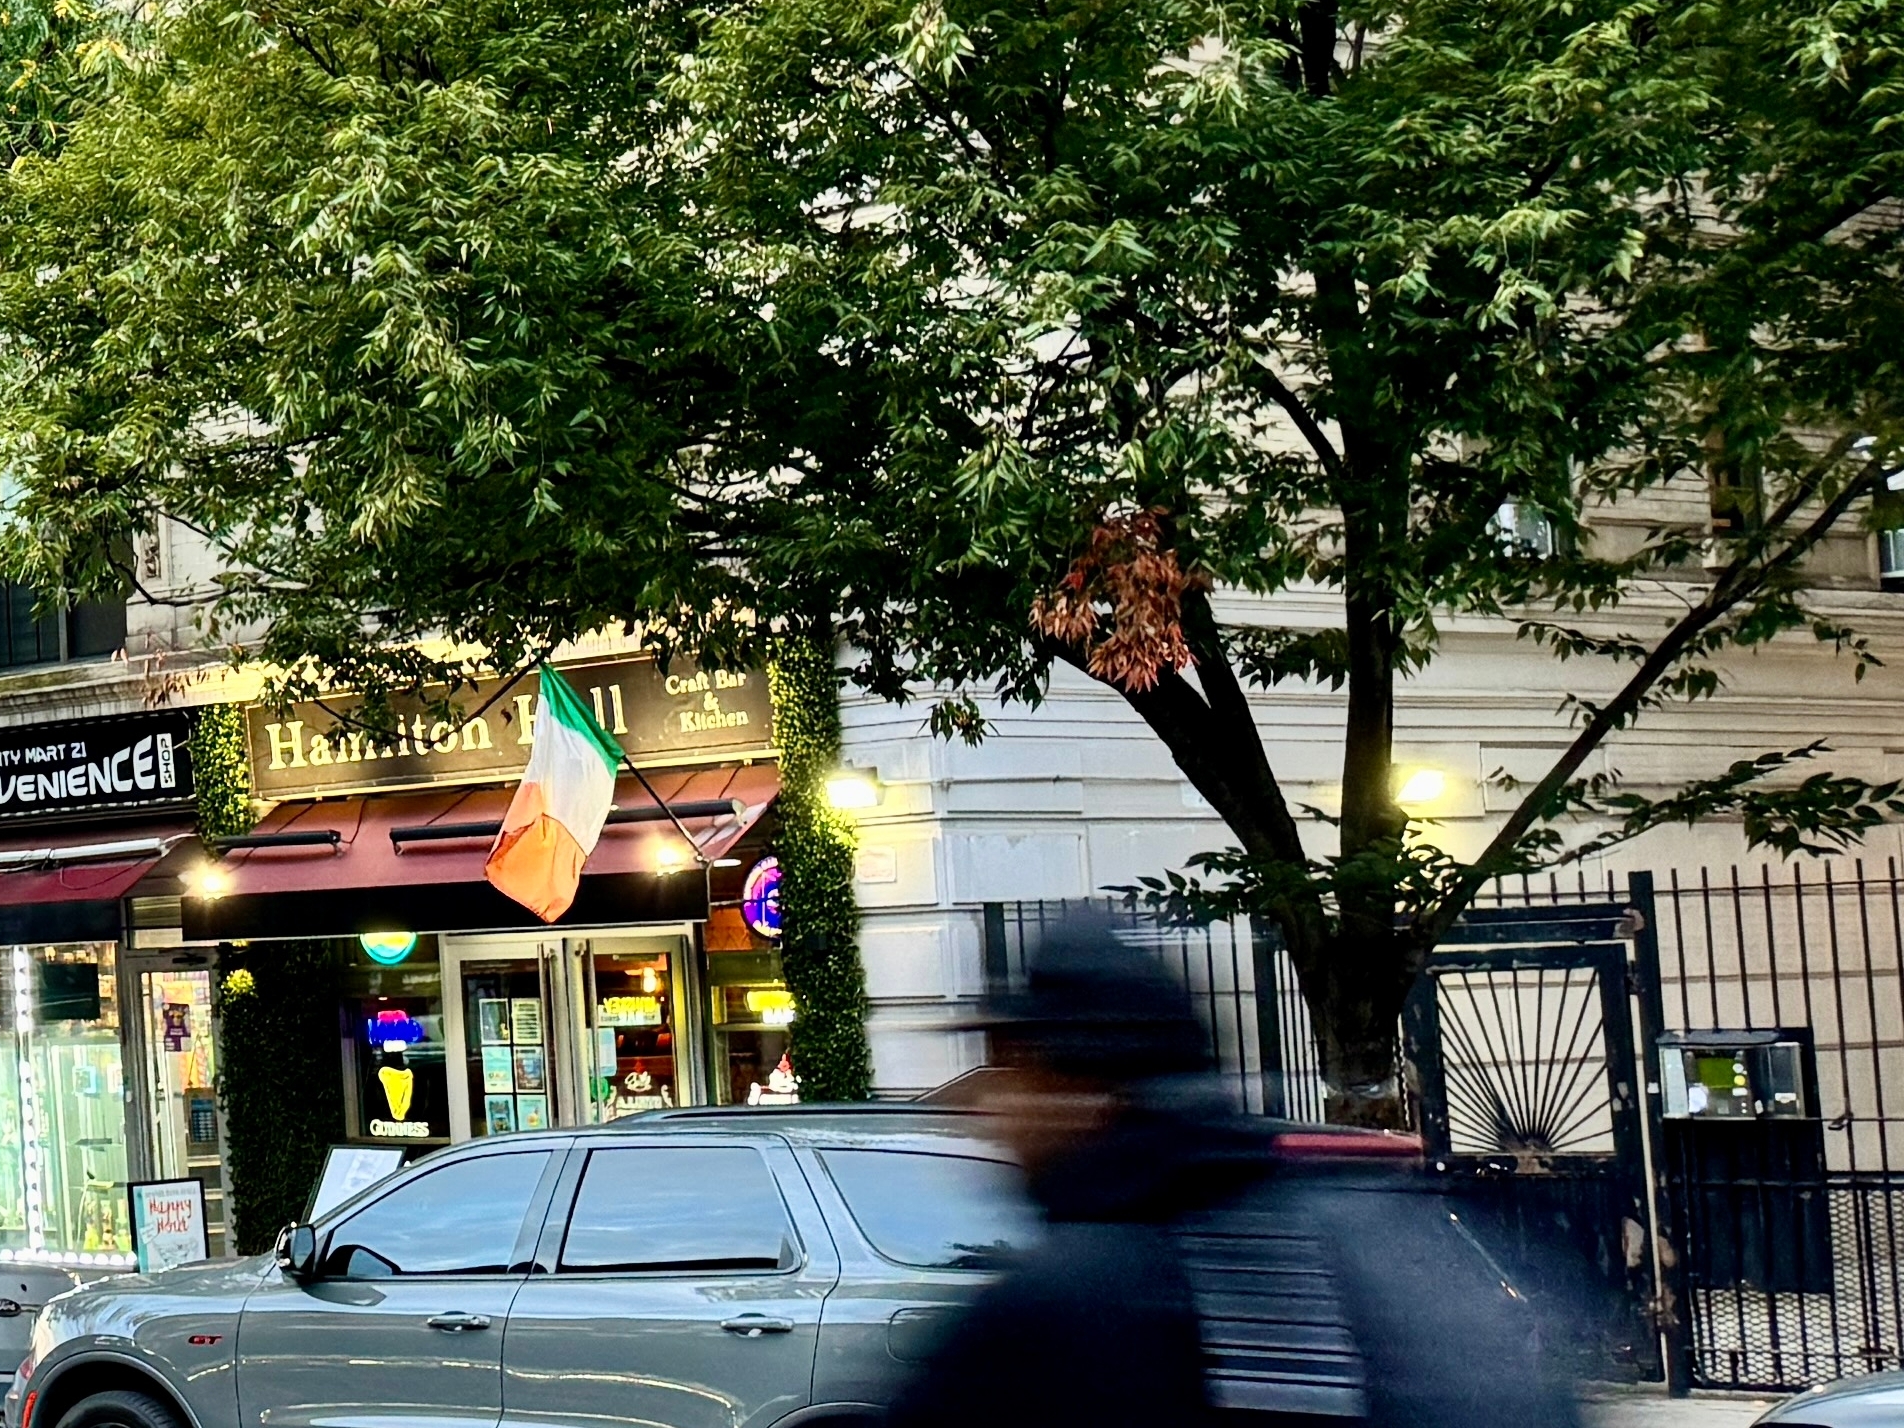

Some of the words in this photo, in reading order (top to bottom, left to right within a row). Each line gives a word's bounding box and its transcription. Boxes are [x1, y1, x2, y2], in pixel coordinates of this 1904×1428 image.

[664, 671, 710, 696] Craft
[715, 668, 747, 689] Bar
[703, 692, 719, 712] &
[513, 684, 628, 746] Hll
[679, 707, 749, 733] Kitchen
[25, 743, 65, 764] MART
[70, 741, 87, 759] 21
[369, 1118, 430, 1137] GUINNESS
[188, 1335, 223, 1345] GT
